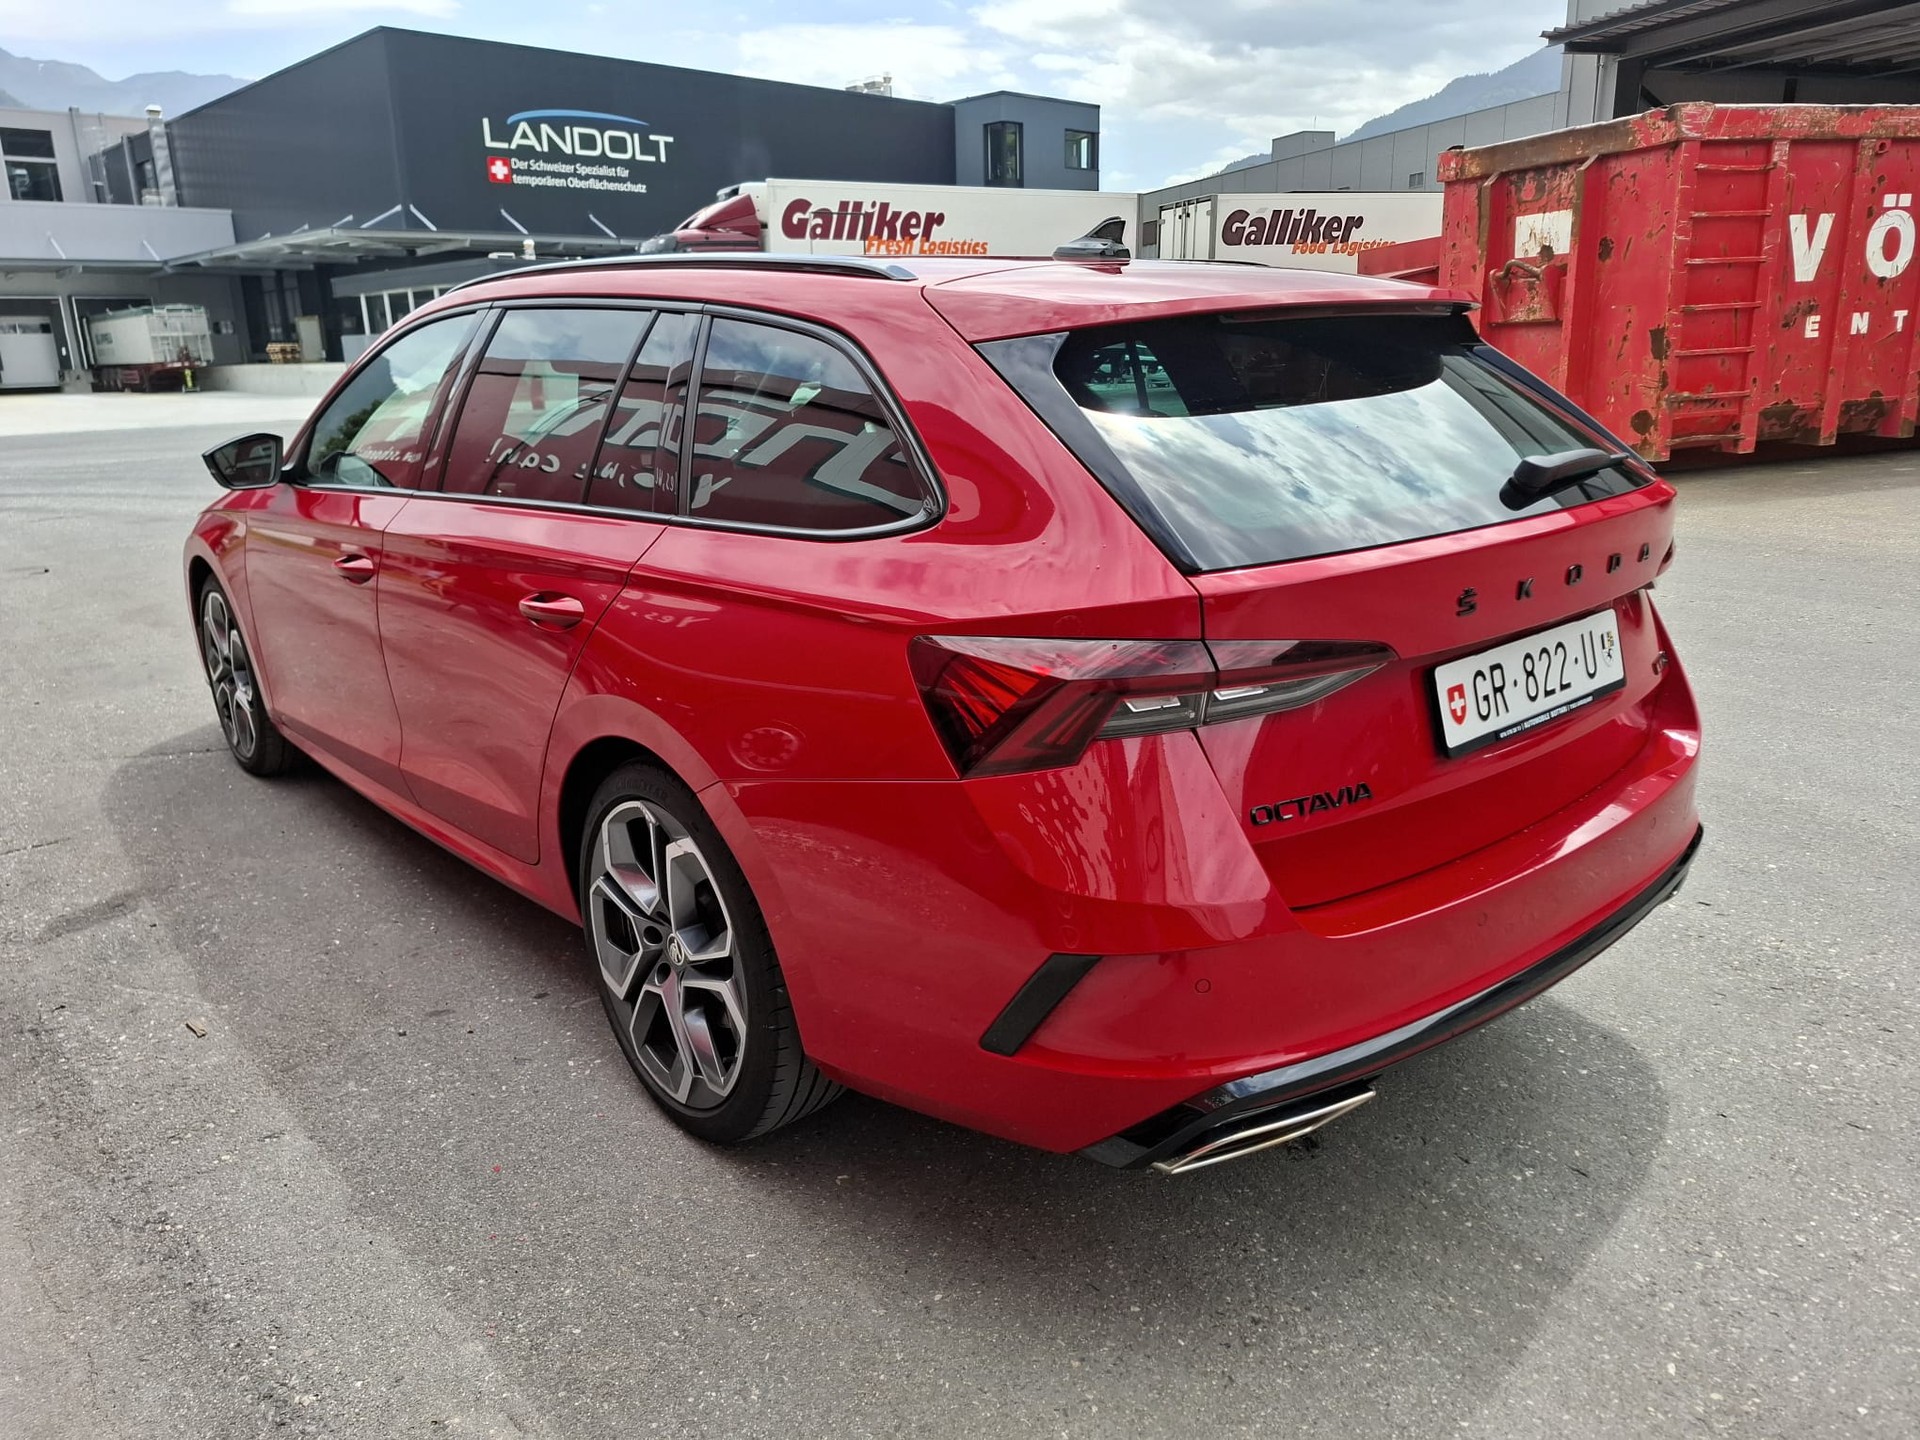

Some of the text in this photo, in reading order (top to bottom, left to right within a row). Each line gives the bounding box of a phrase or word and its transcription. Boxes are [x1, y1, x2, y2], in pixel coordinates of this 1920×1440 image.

[482, 117, 674, 163] LANDOLT
[511, 157, 630, 178] Der Schweizer Spezialist für
[512, 173, 647, 193] temporären Oberflächenschutz
[781, 198, 945, 242] Galliker
[1221, 208, 1364, 246] Galliker
[866, 236, 988, 255] Fresh Logistics
[1291, 239, 1329, 255] Food
[1456, 543, 1650, 616] ŠKODA
[1250, 782, 1373, 826] OCTAVIA
